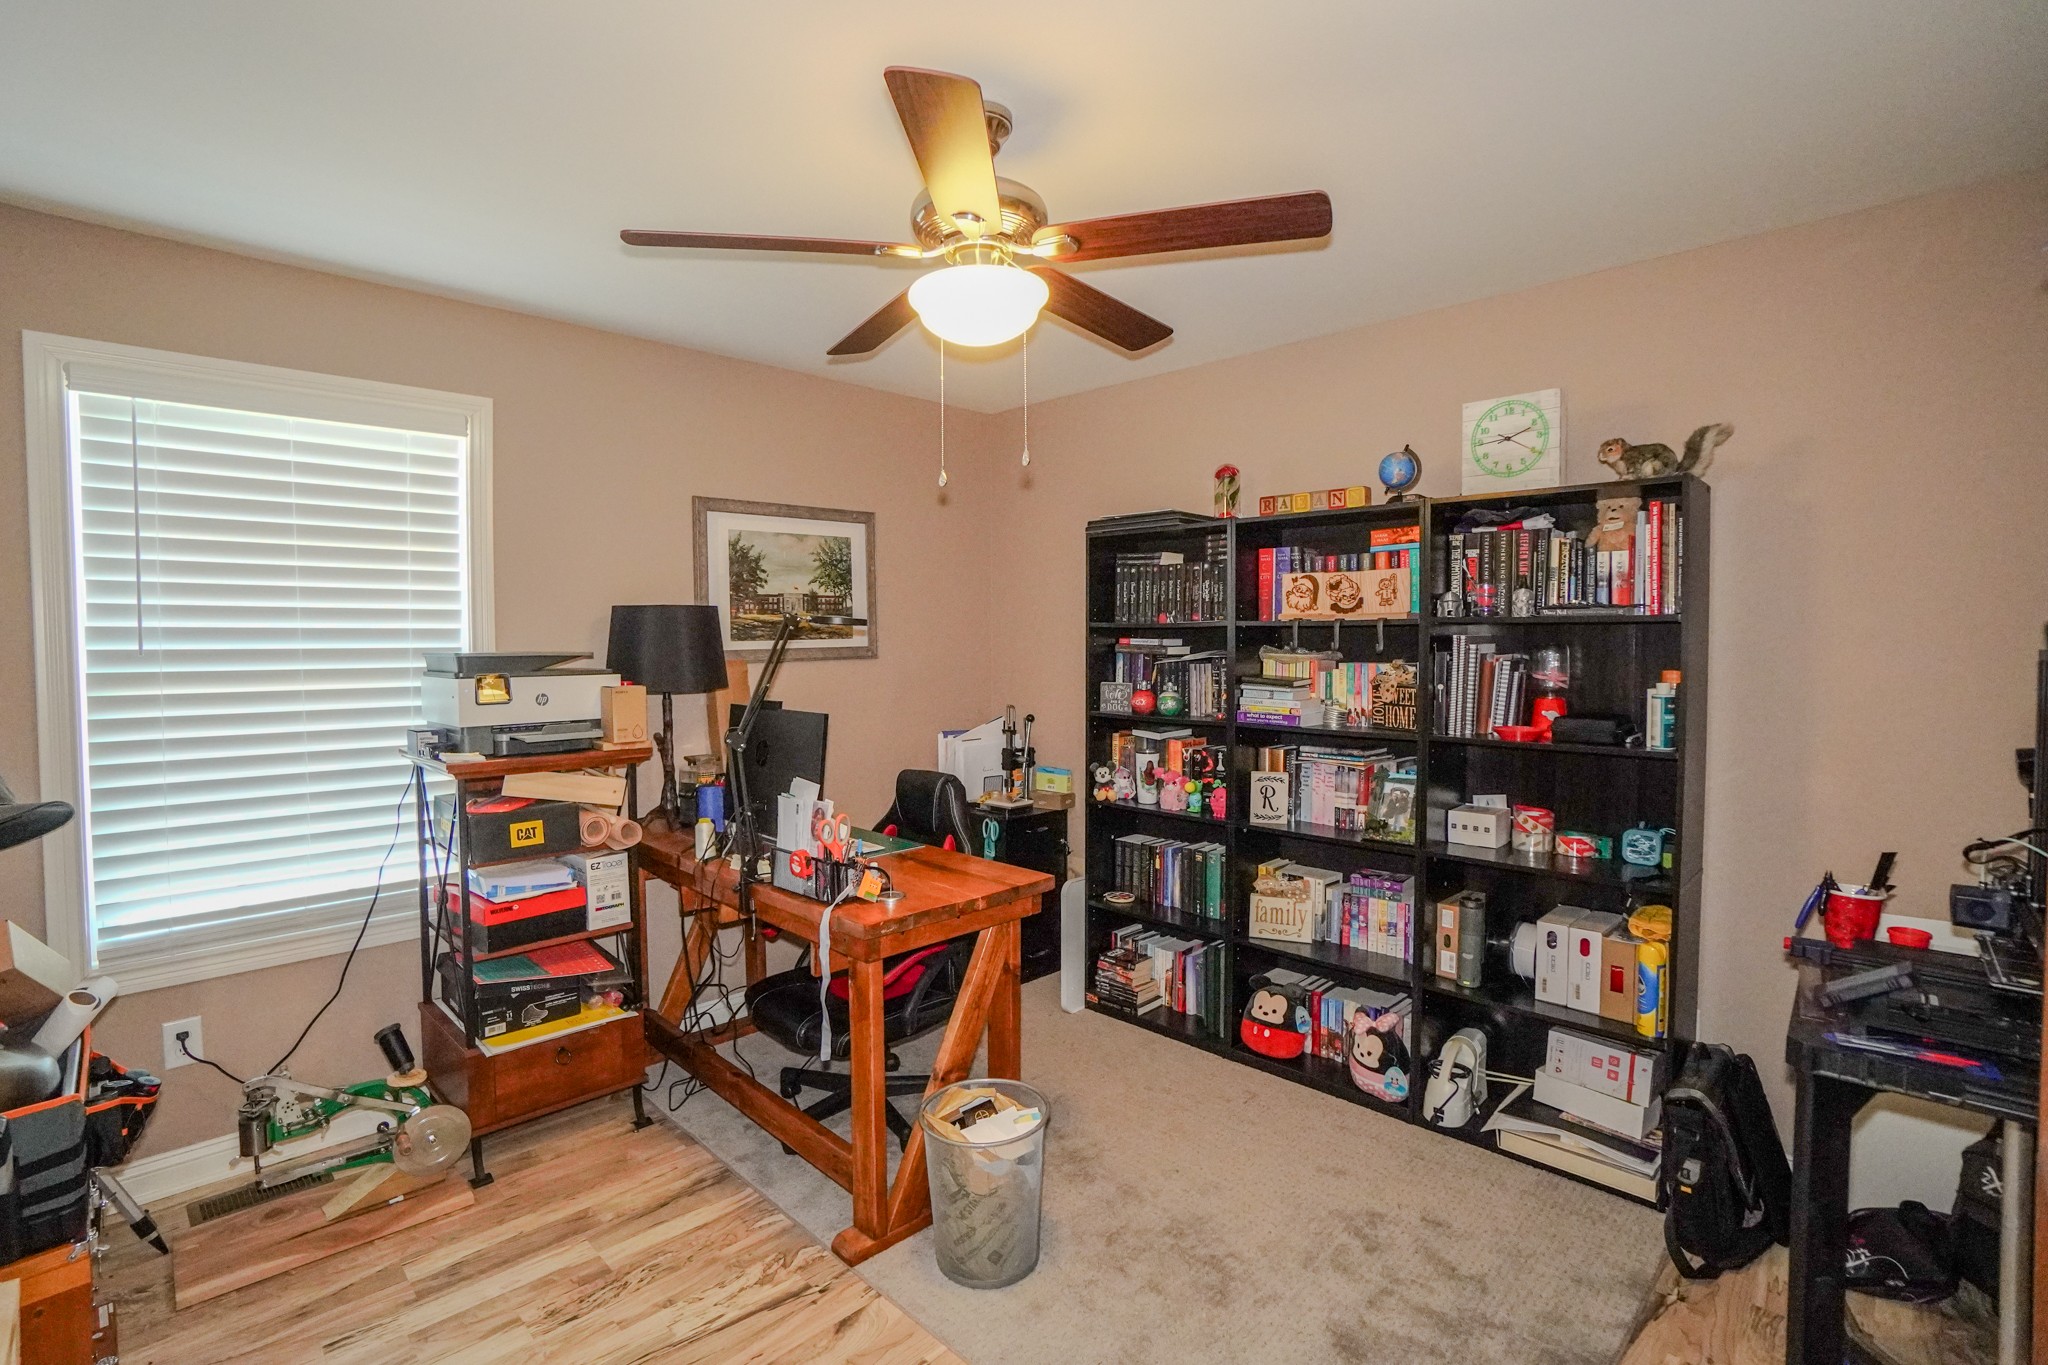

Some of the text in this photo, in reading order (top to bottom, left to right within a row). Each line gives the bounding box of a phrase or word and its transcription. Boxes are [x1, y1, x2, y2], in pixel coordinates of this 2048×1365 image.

[1505, 407, 1515, 415] 12
[1451, 549, 1461, 559] THE
[1520, 533, 1529, 576] STEPHEN KING
[1385, 705, 1417, 730] HOME
[1260, 784, 1279, 813] R
[516, 826, 538, 841] CAT
[595, 902, 625, 912] TOGRAPH
[1254, 899, 1308, 930] family
